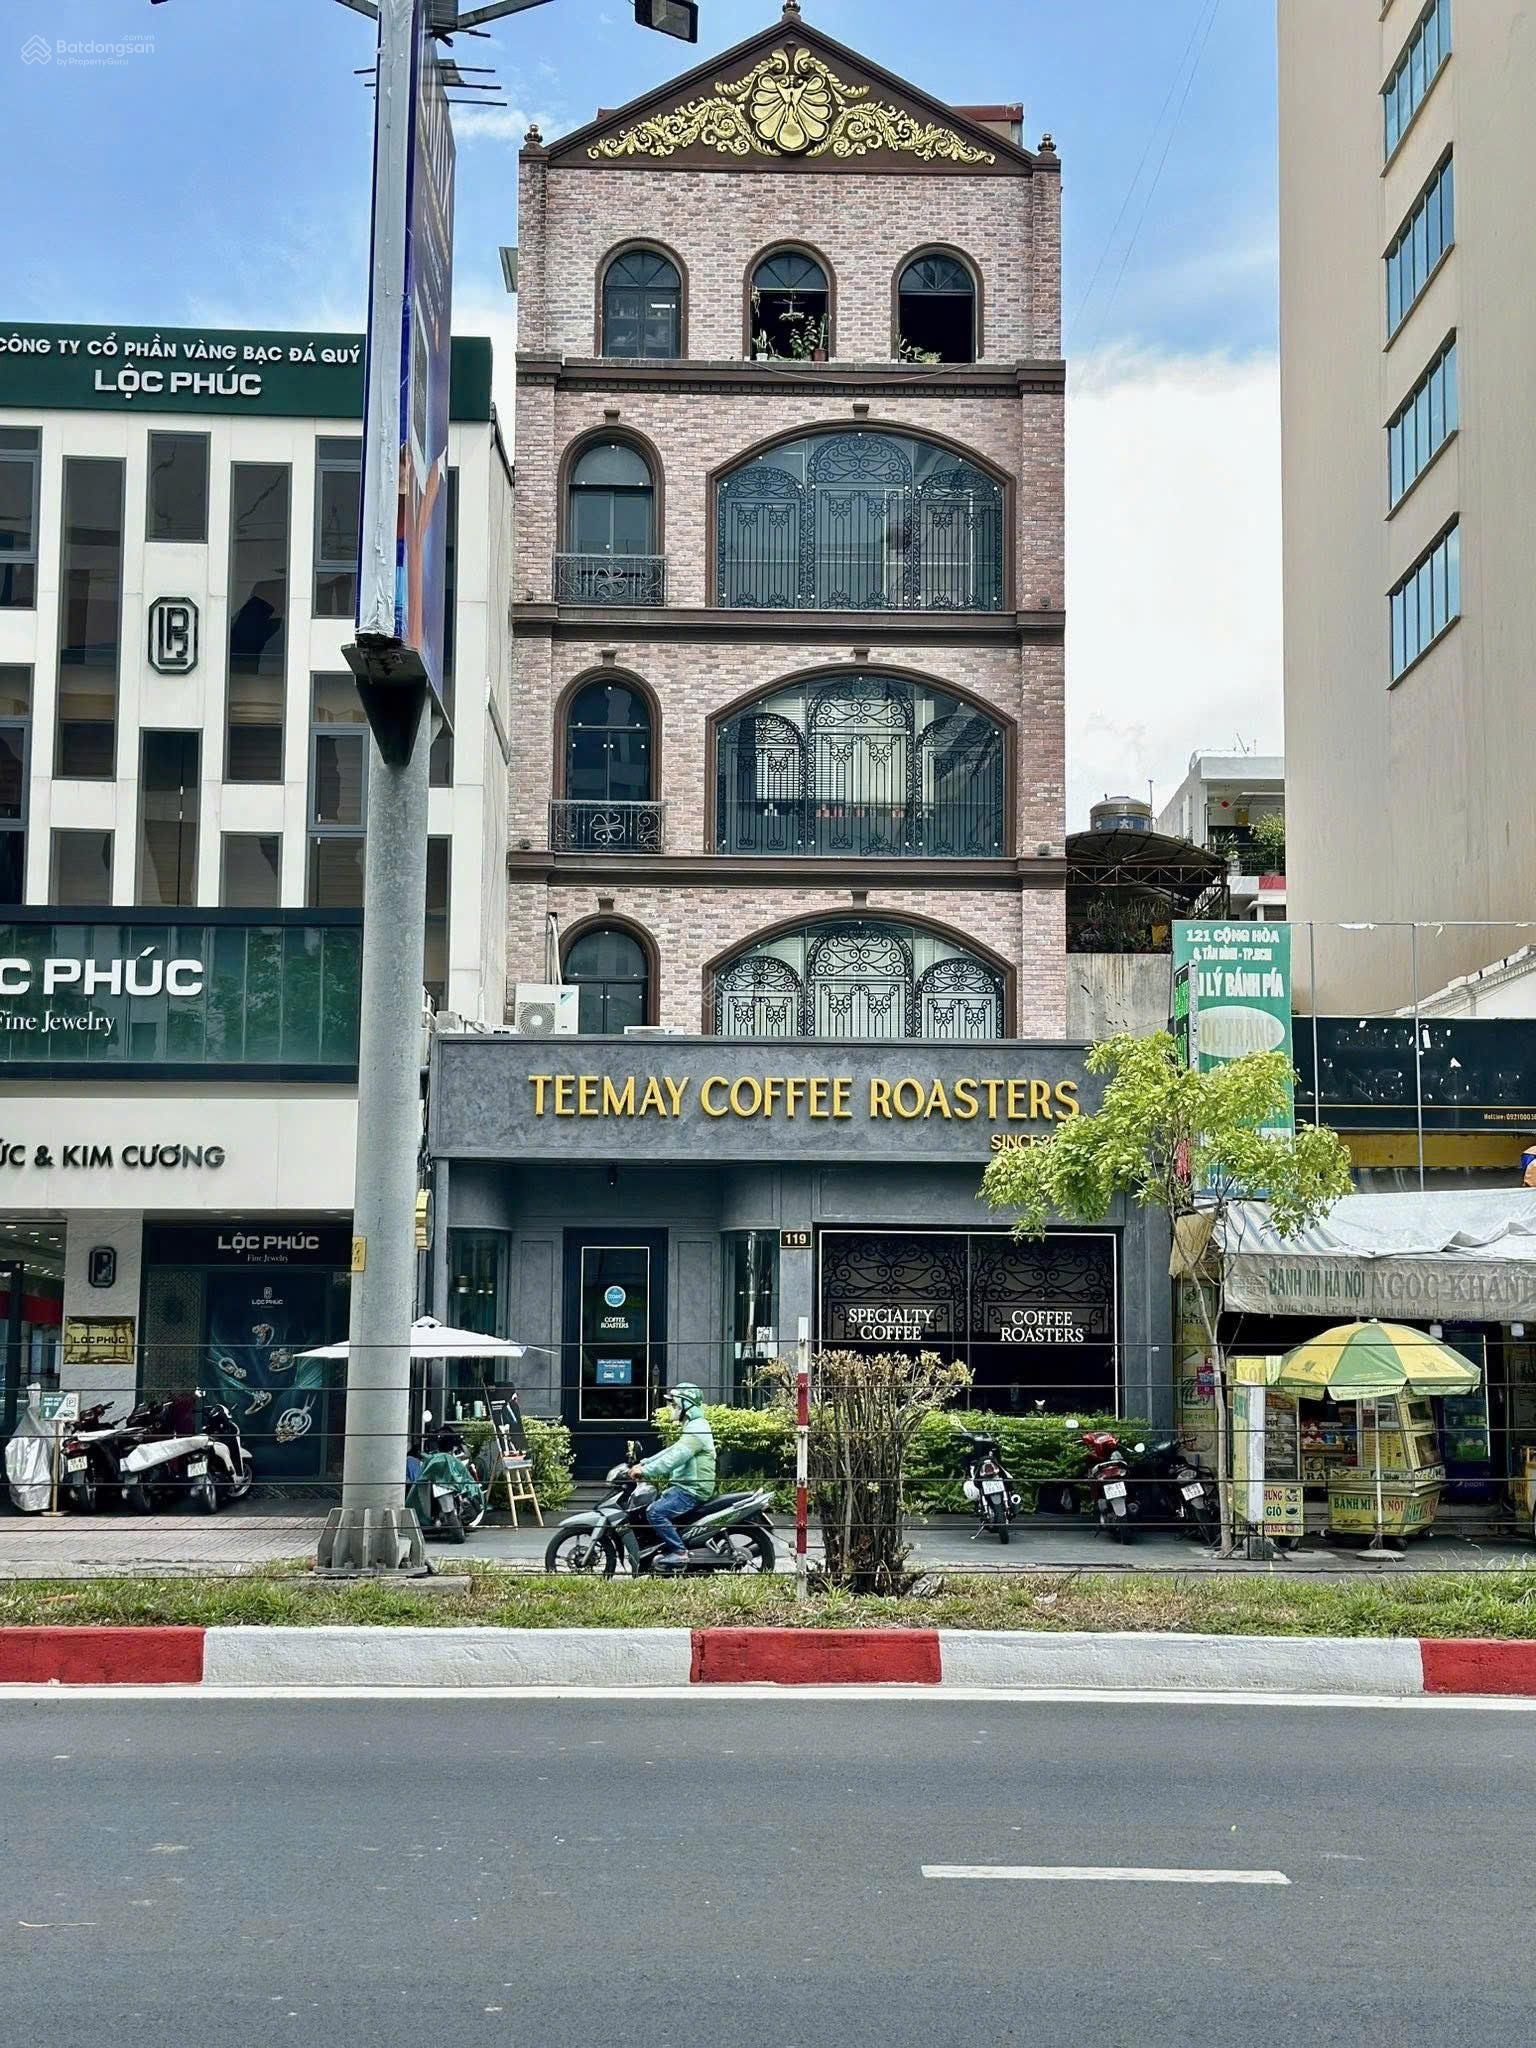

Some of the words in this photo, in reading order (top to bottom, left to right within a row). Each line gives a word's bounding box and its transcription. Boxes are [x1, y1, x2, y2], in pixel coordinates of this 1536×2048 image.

[0, 333, 52, 354] CÔNG
[58, 340, 81, 354] TY
[87, 332, 118, 356] CỔ
[124, 334, 177, 358] PHẦN
[183, 339, 237, 360] VÀNG
[243, 346, 283, 365] BẠC
[288, 342, 316, 362] ĐÁ
[321, 344, 361, 364] QUÝ
[94, 362, 164, 399] LỘC
[170, 365, 263, 396] PHÚC
[1186, 928, 1211, 943] 121
[1252, 927, 1280, 943] HÒA
[43, 946, 204, 997] PHÚC
[1206, 966, 1223, 997] LÝ
[1225, 966, 1260, 997] BÁNH
[41, 1009, 115, 1037] Jewelry
[528, 1074, 690, 1117] TEEMAY
[700, 1075, 853, 1119] COFFEE
[869, 1078, 1081, 1120] ROASTERS
[34, 1144, 54, 1168] &
[62, 1145, 114, 1168] KIM
[121, 1143, 226, 1169] CƯƠNG
[217, 1231, 260, 1254] LỘC
[263, 1231, 320, 1250] PHÚC
[785, 1235, 807, 1245] 119
[848, 1308, 934, 1325] SPECIALTY
[1011, 1310, 1073, 1326] COFFEE
[860, 1325, 922, 1341] COFFEE
[999, 1327, 1085, 1343] ROASTERS
